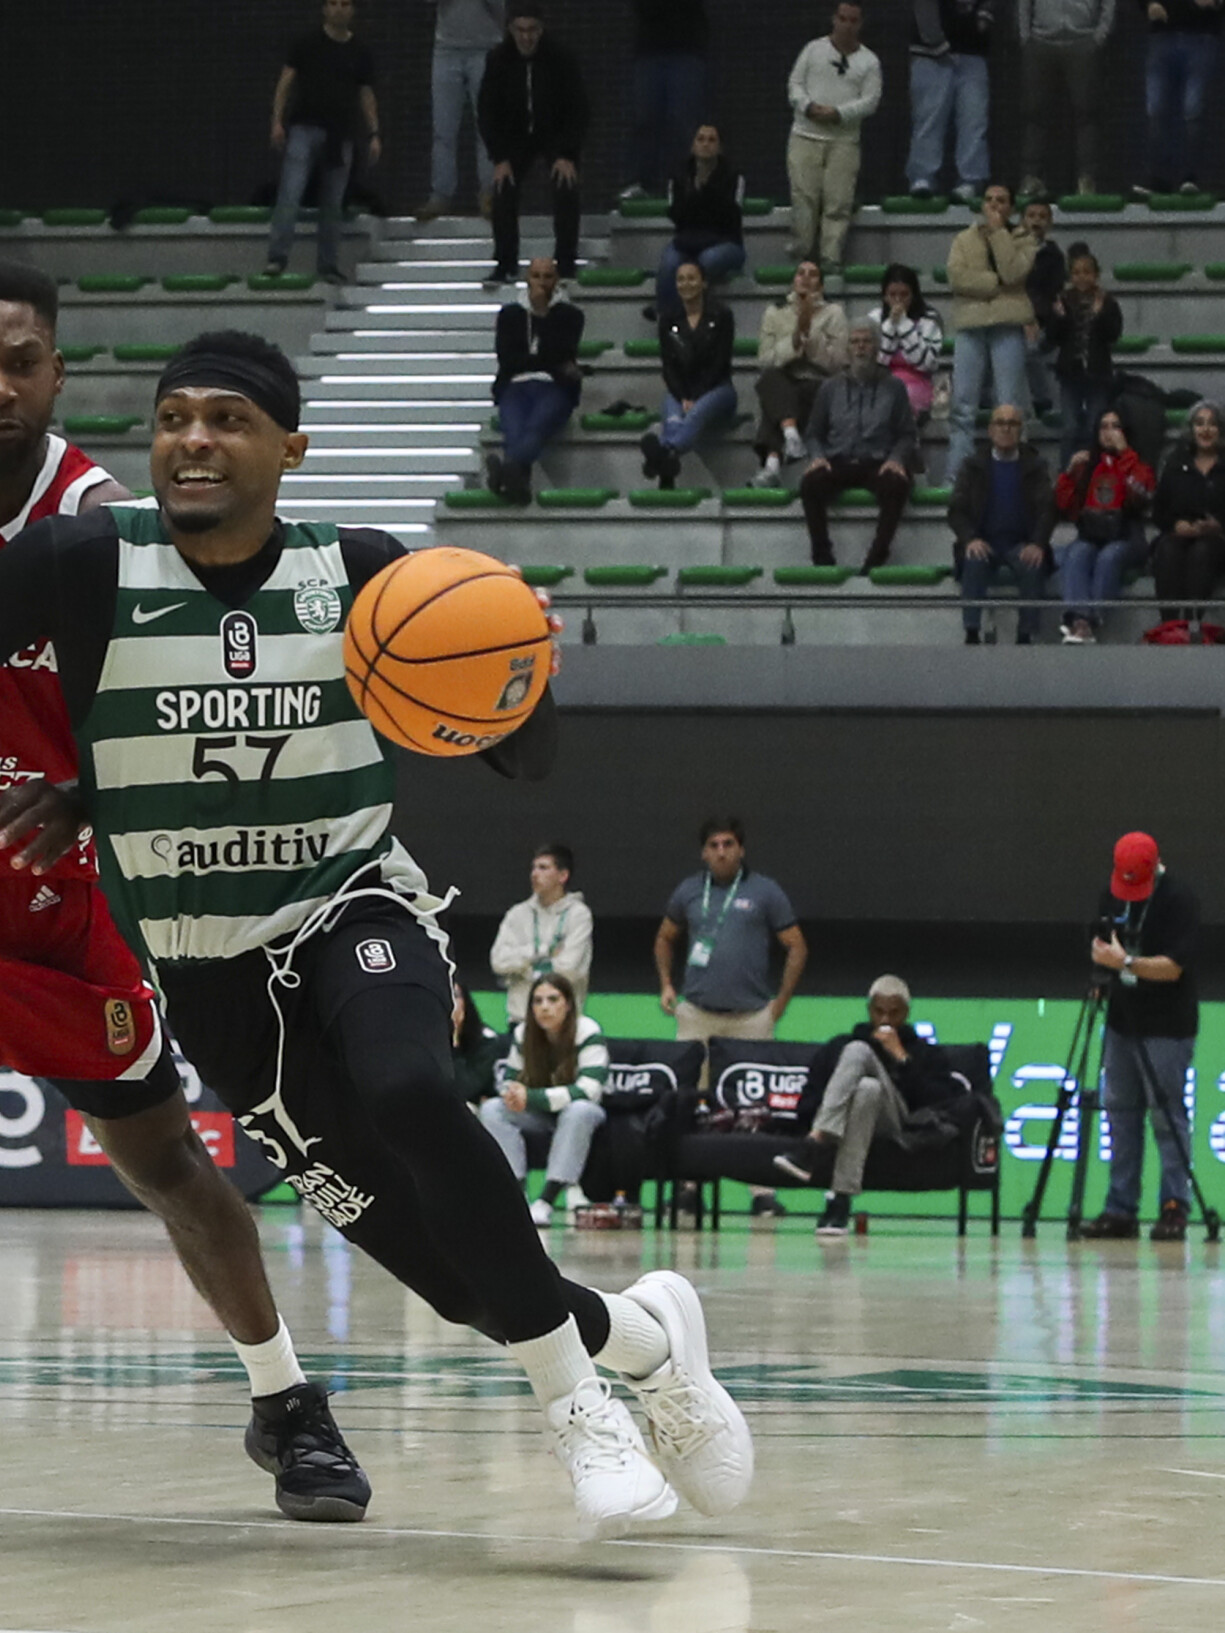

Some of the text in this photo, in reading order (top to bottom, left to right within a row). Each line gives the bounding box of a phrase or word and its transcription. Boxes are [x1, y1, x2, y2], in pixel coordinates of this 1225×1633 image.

[298, 578, 328, 590] SCP
[156, 685, 321, 730] SPORTING
[192, 734, 292, 808] 57
[176, 827, 329, 870] auditiv
